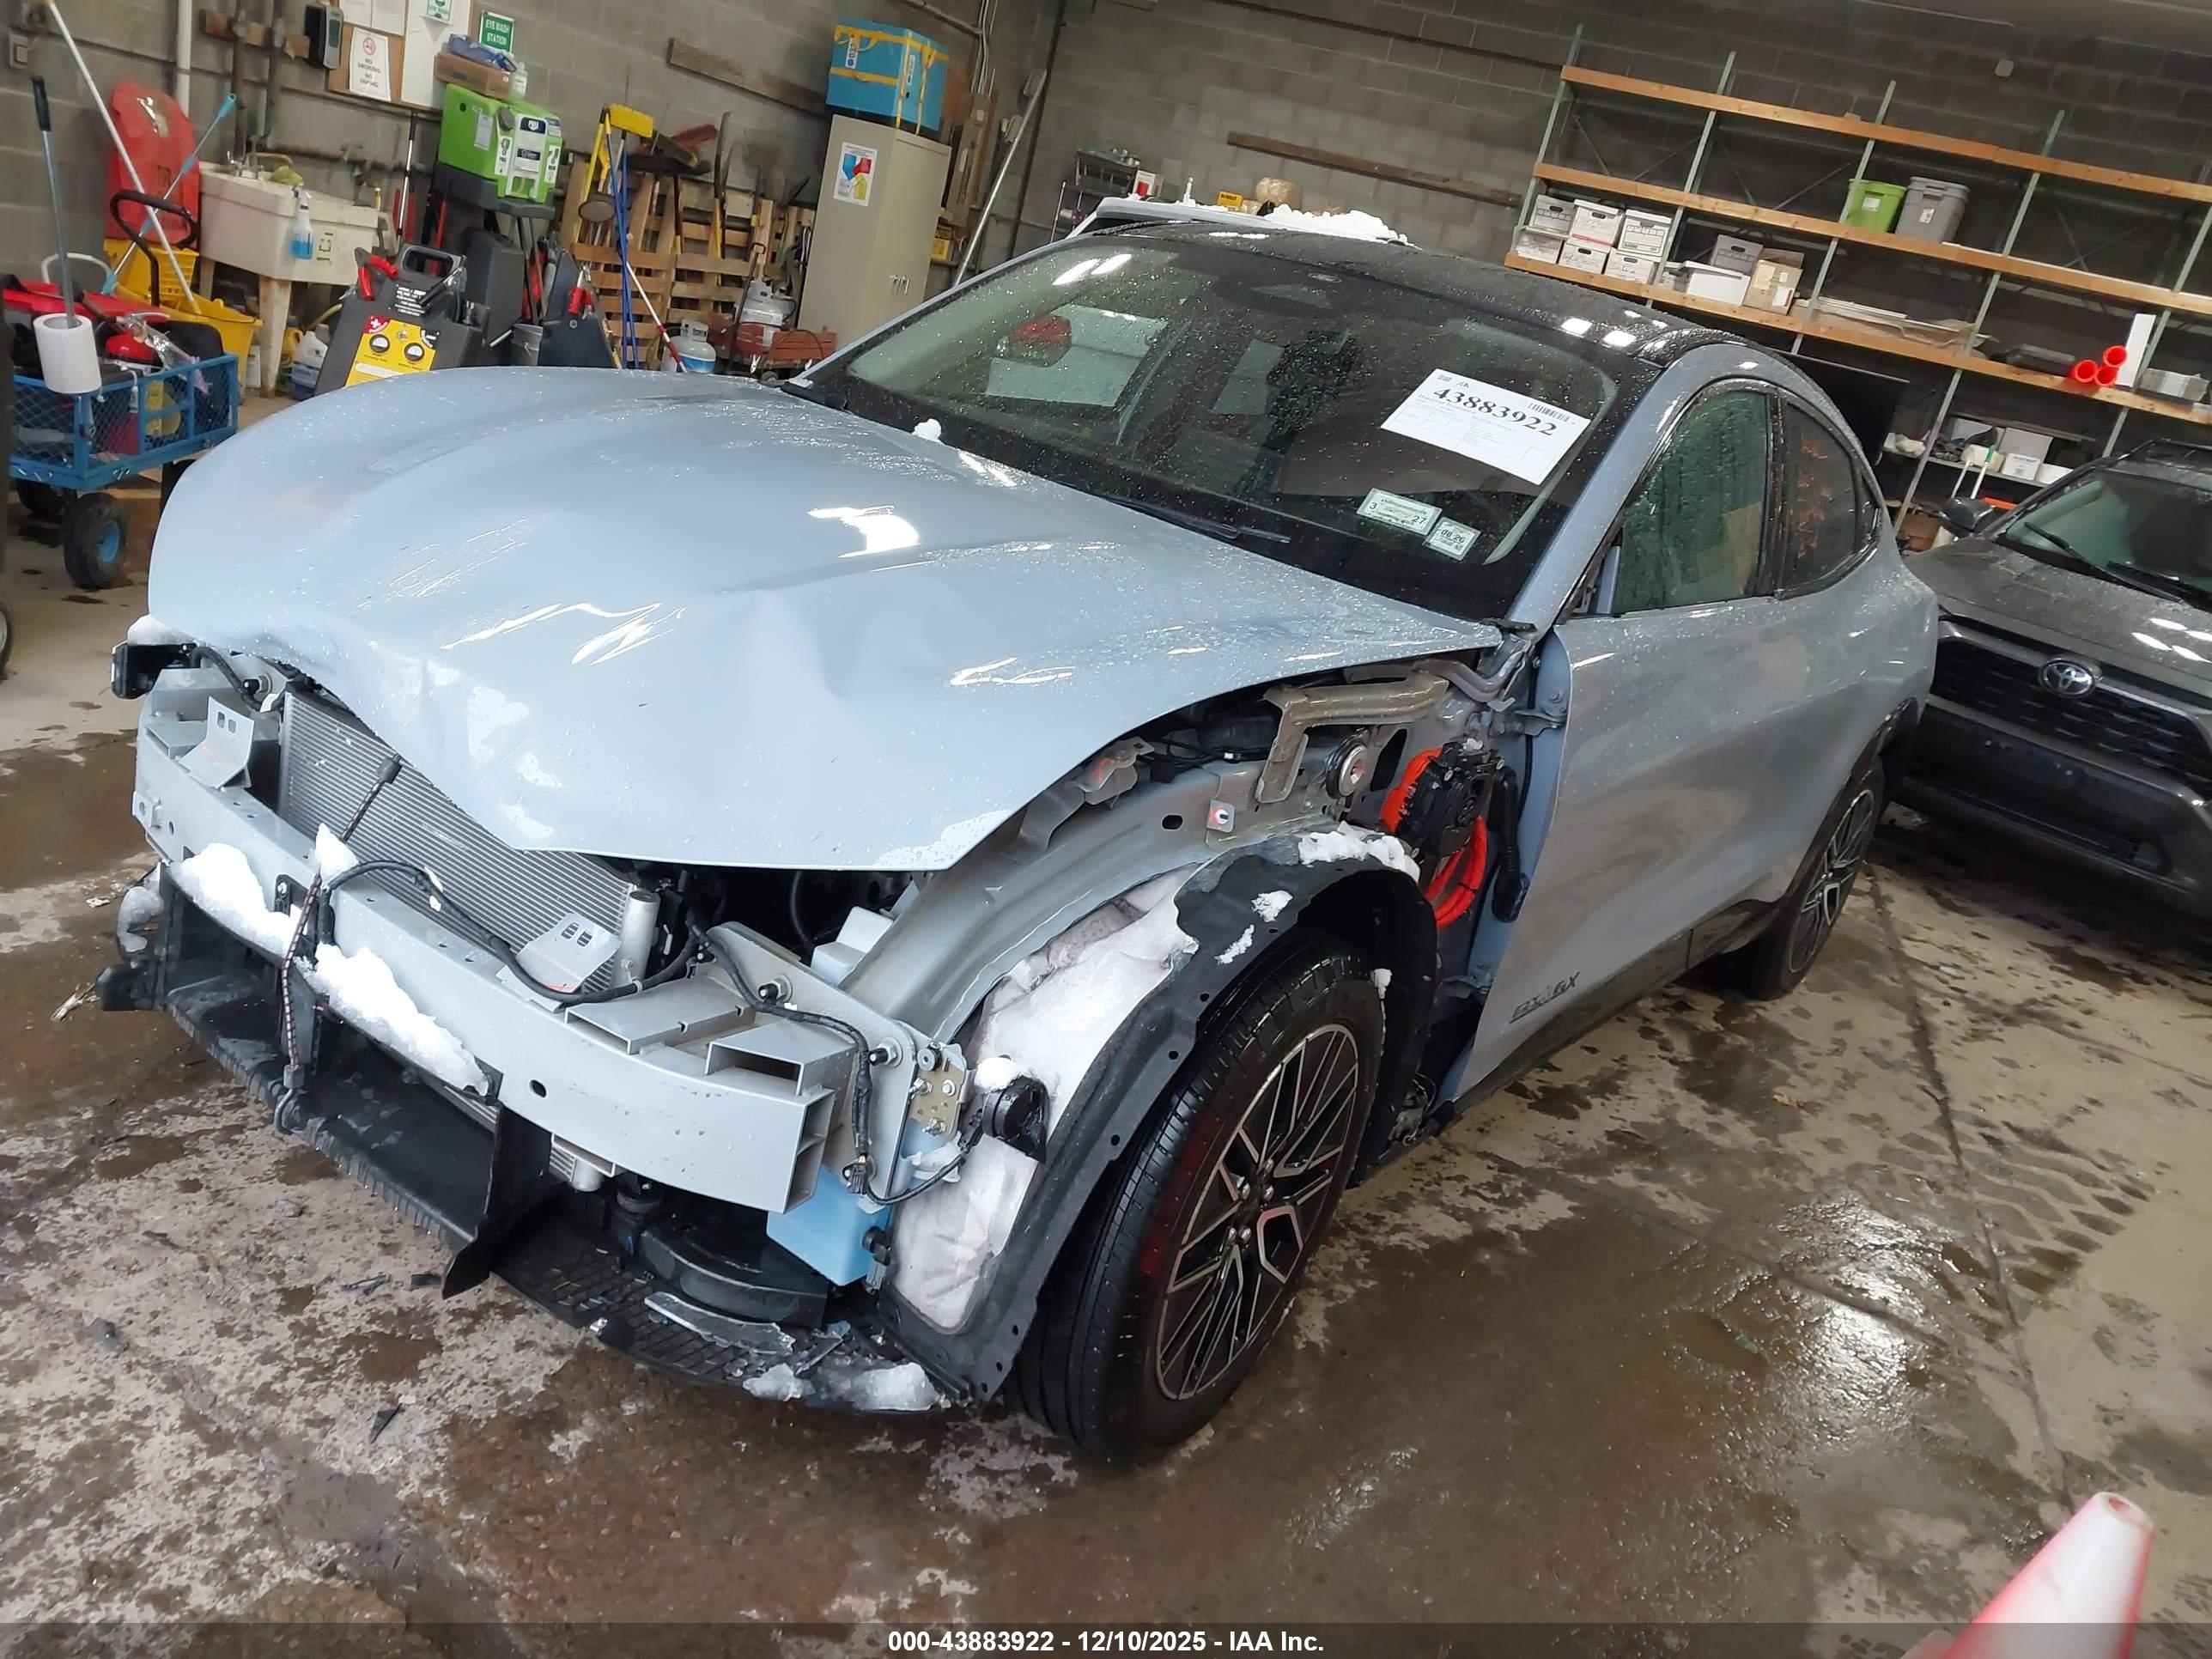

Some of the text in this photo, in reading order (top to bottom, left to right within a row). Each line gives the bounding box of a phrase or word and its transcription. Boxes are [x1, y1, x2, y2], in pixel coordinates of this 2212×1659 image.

[485, 19, 510, 33] EYE WASH
[486, 32, 507, 46] STATION
[357, 62, 381, 74] SMOKING
[1433, 388, 1558, 436] 43883922
